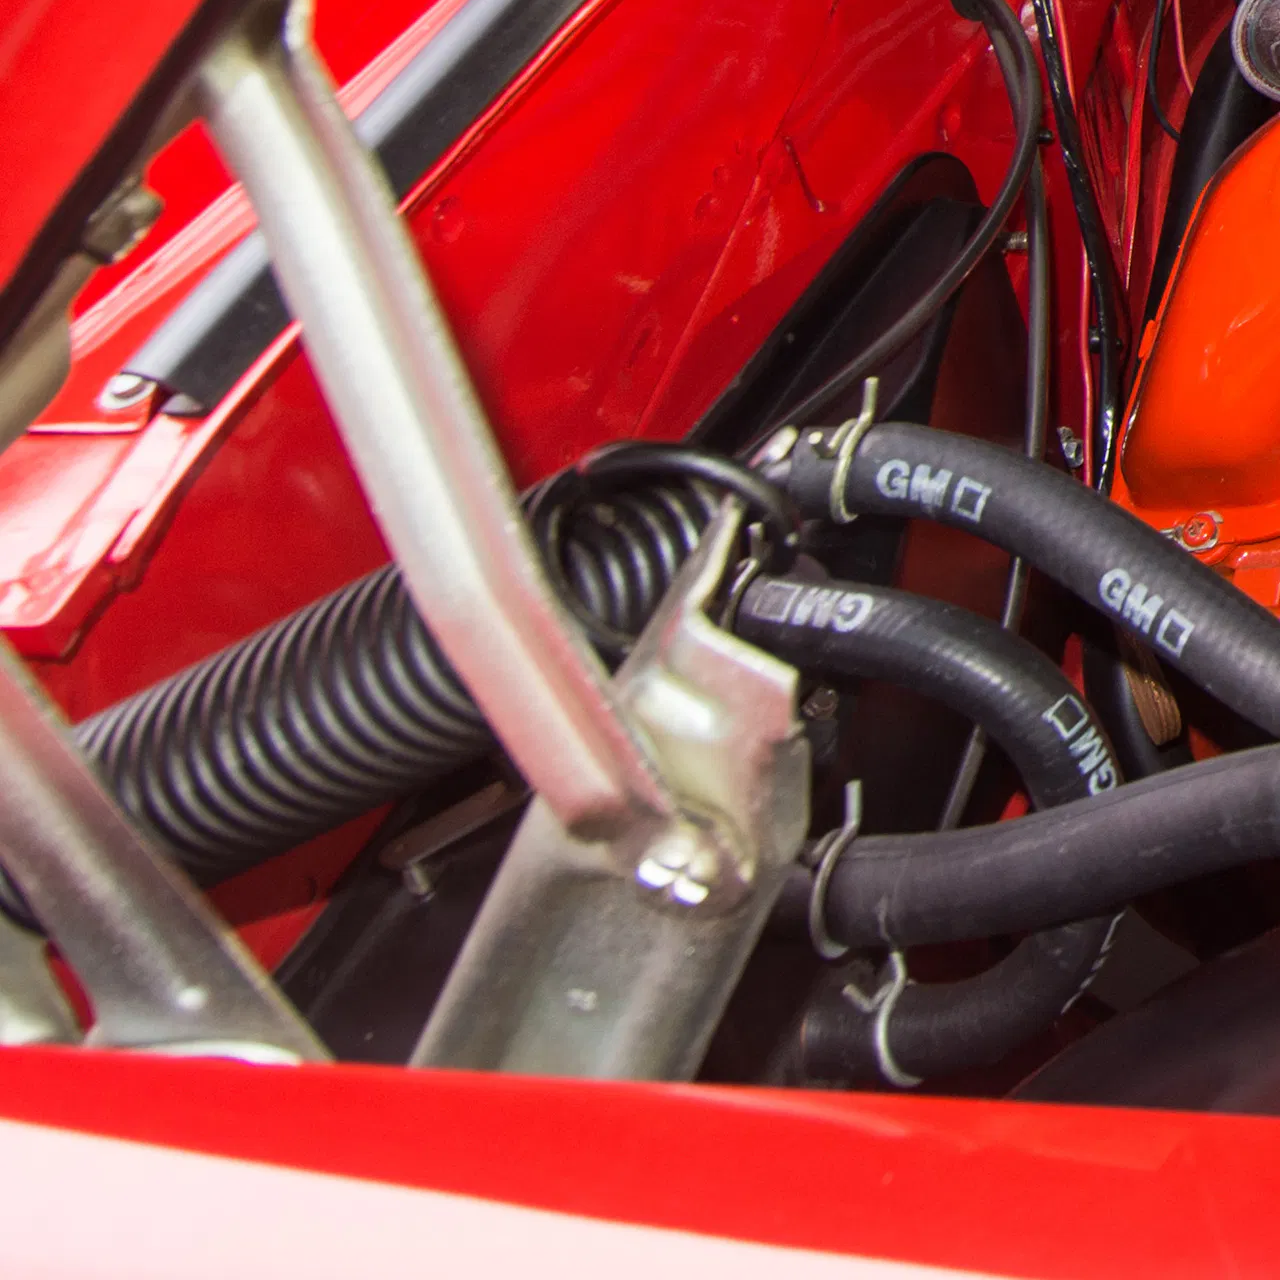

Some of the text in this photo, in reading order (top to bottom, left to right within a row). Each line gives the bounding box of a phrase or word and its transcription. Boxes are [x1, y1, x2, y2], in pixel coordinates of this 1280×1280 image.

[876, 459, 952, 508] GM
[793, 585, 874, 631] GM
[1099, 569, 1164, 633] GM
[1069, 730, 1118, 795] GM
